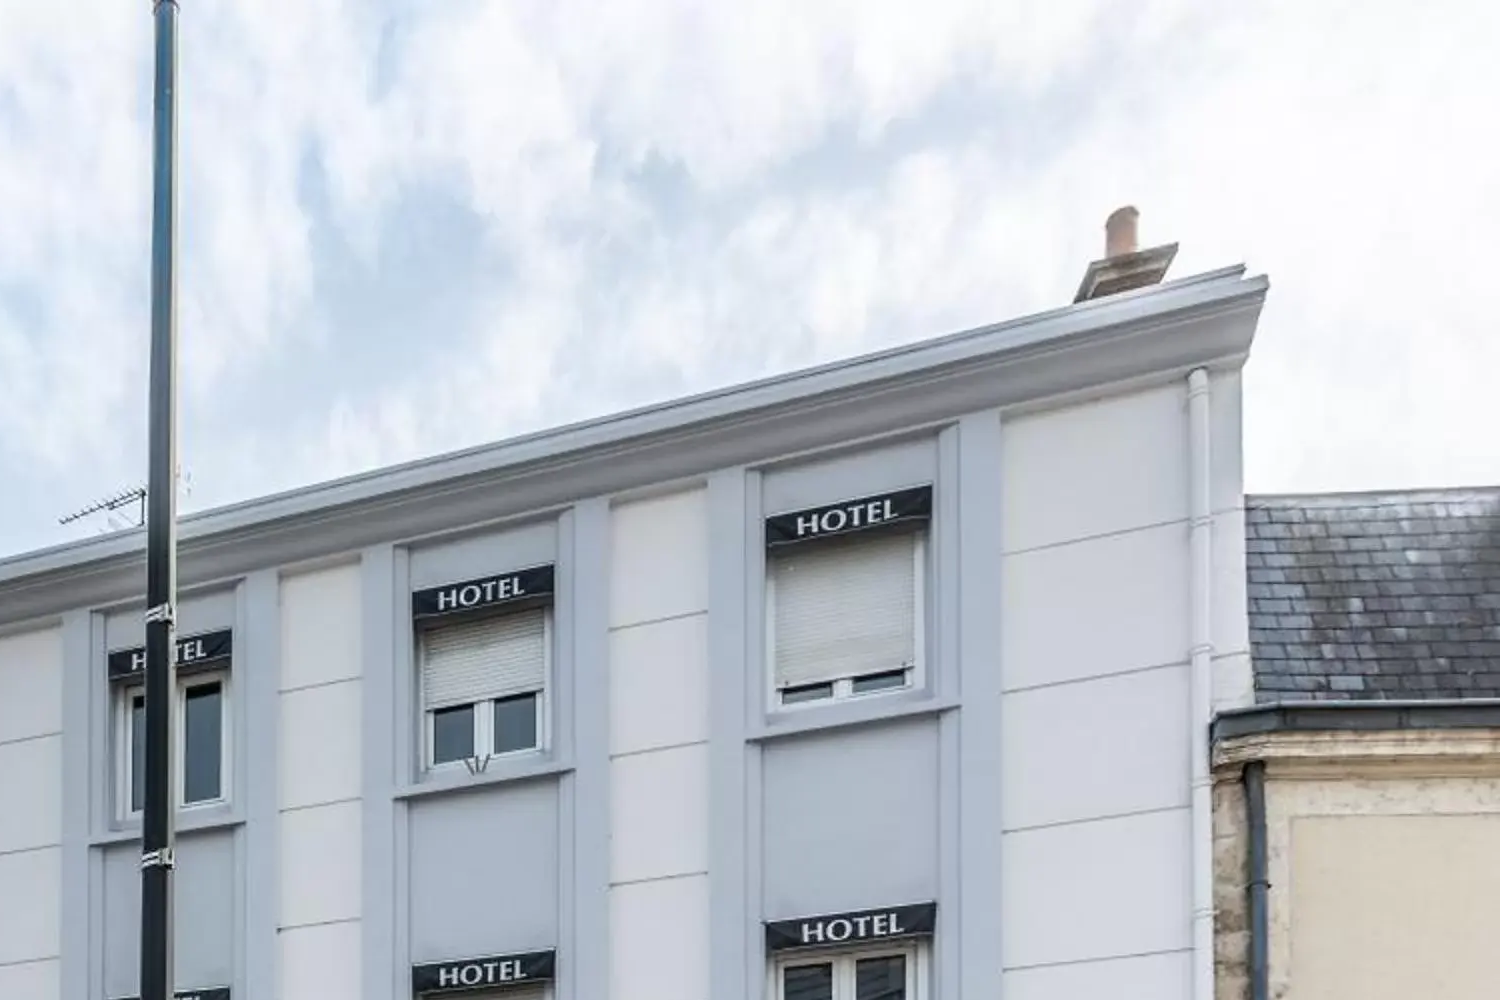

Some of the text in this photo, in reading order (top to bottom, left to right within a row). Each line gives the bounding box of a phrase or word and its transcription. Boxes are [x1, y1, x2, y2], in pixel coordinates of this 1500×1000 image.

[797, 499, 899, 536] HOTEL
[438, 577, 525, 611] HOTEL
[131, 639, 207, 671] HTEL
[802, 913, 904, 943] HOTEL
[440, 959, 527, 987] HOTEL
